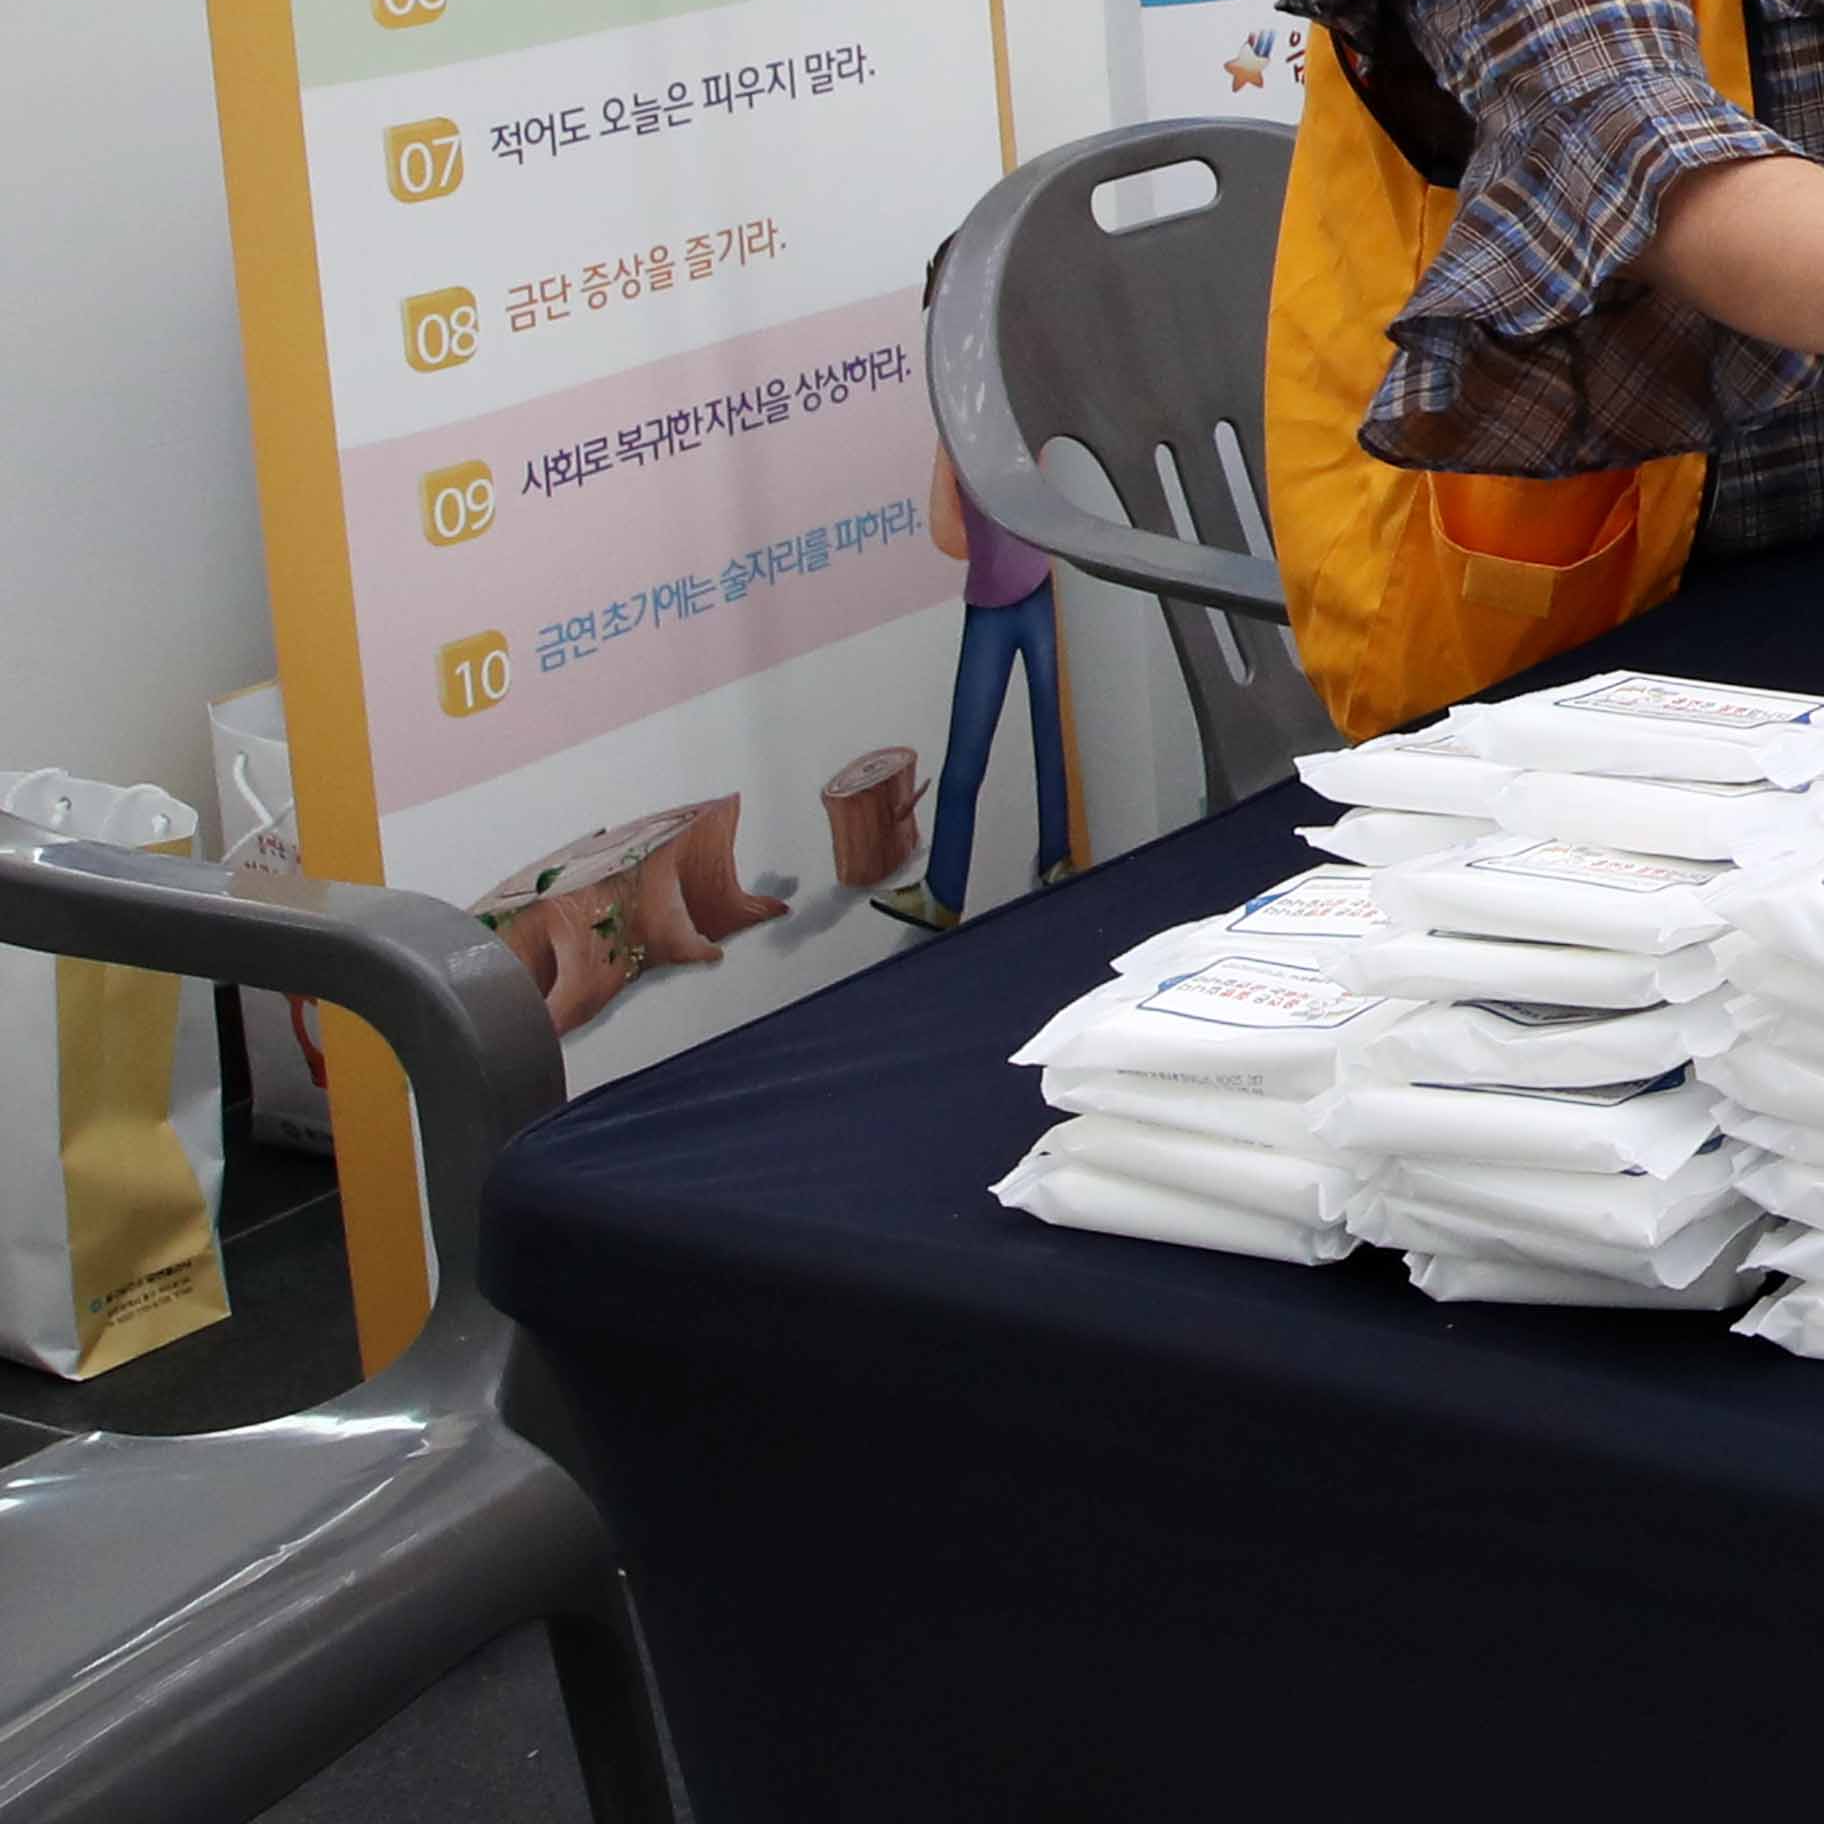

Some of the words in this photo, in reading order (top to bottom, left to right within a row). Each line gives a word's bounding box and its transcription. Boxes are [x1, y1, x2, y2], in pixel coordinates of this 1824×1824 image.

[399, 135, 462, 194] 07
[490, 108, 590, 166] 적어도
[600, 81, 694, 138] 오늘은
[701, 58, 798, 116] 피우지
[805, 44, 875, 94] 말라.
[417, 306, 480, 365] 08
[505, 275, 572, 333] 금단
[580, 243, 674, 309] 증상을
[684, 217, 788, 278] 즐기라.
[433, 477, 496, 540] 09
[521, 435, 610, 500] 사회로
[618, 408, 702, 470] 복귀한
[705, 378, 790, 439] 자신을
[794, 344, 911, 412] 상상하라.
[455, 648, 511, 711] 10
[537, 613, 598, 673] 금연
[601, 575, 715, 639] 초기에는
[720, 528, 830, 604] 술자리를
[836, 499, 922, 557] 피하라.
